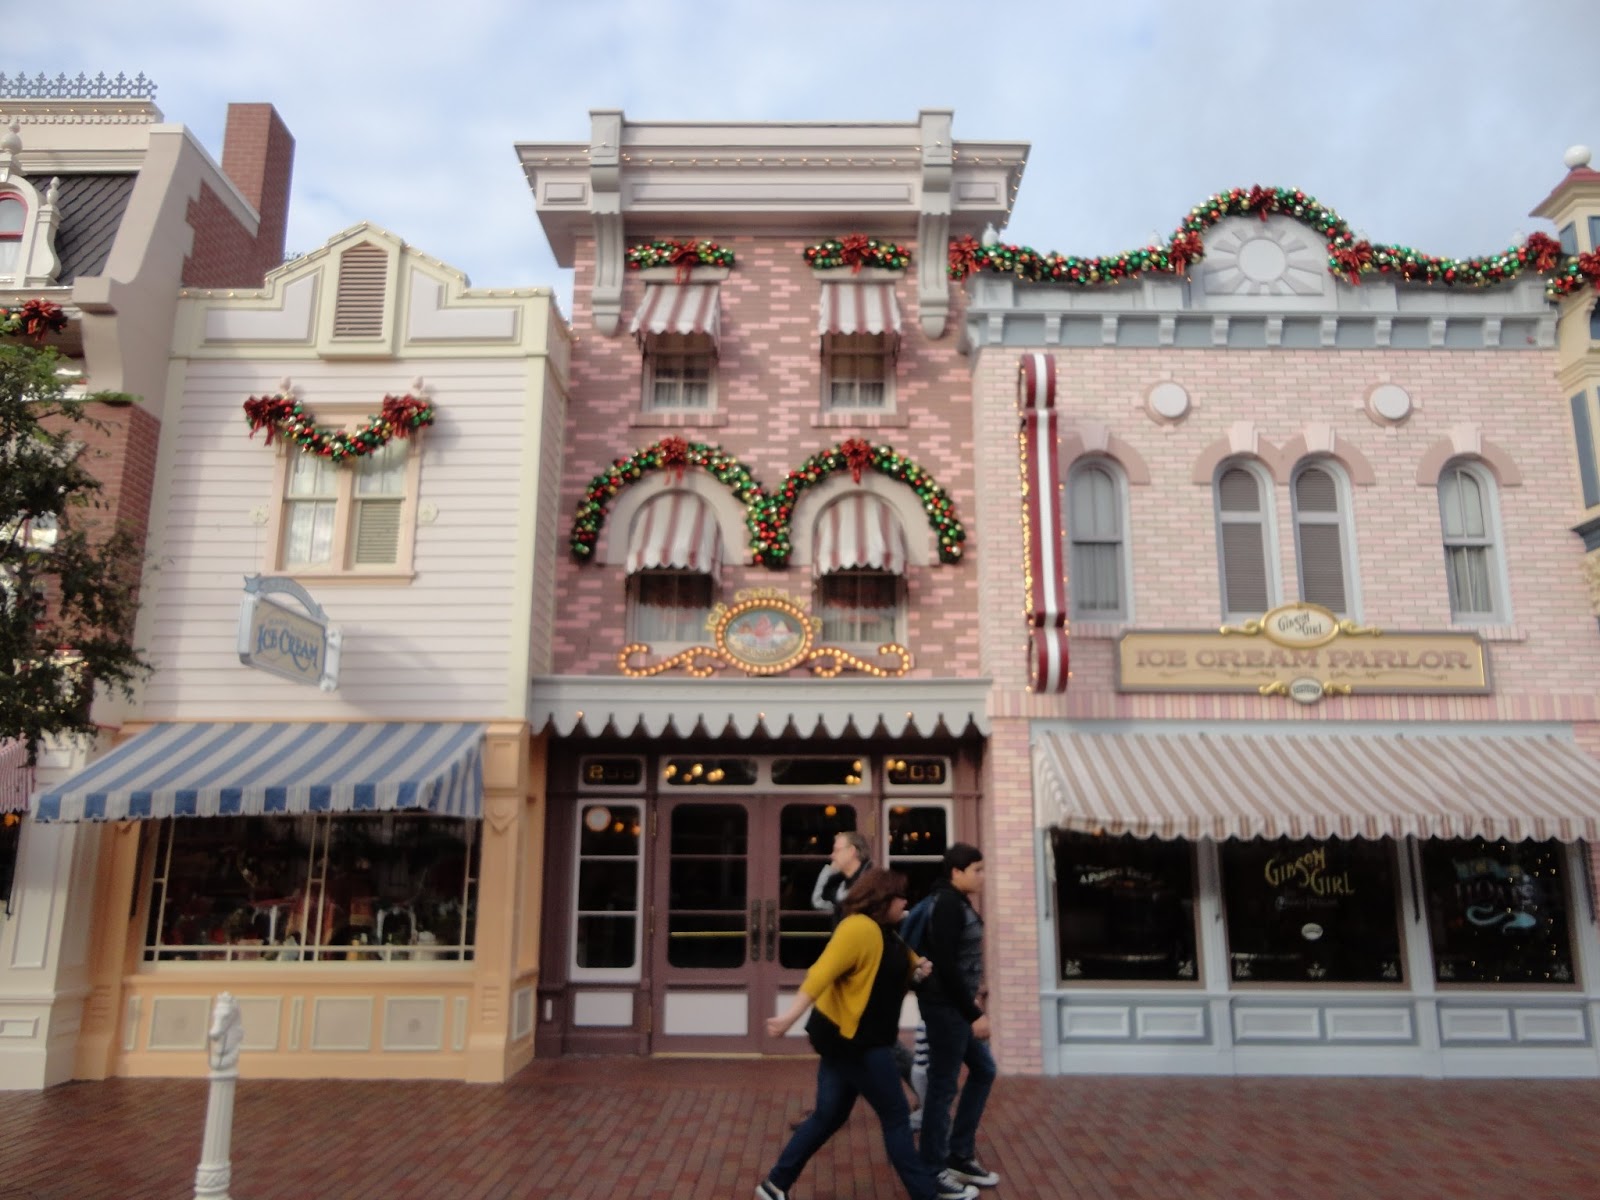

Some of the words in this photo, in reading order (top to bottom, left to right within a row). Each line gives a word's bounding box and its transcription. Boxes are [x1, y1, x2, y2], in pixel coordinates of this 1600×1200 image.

[256, 624, 277, 655] ICE
[280, 628, 319, 672] CREAM
[1135, 650, 1187, 668] ICE
[1195, 650, 1320, 668] CREAM
[1327, 650, 1472, 669] PARLOR
[1264, 846, 1326, 887] GIBSON
[1310, 867, 1356, 896] GIRL
